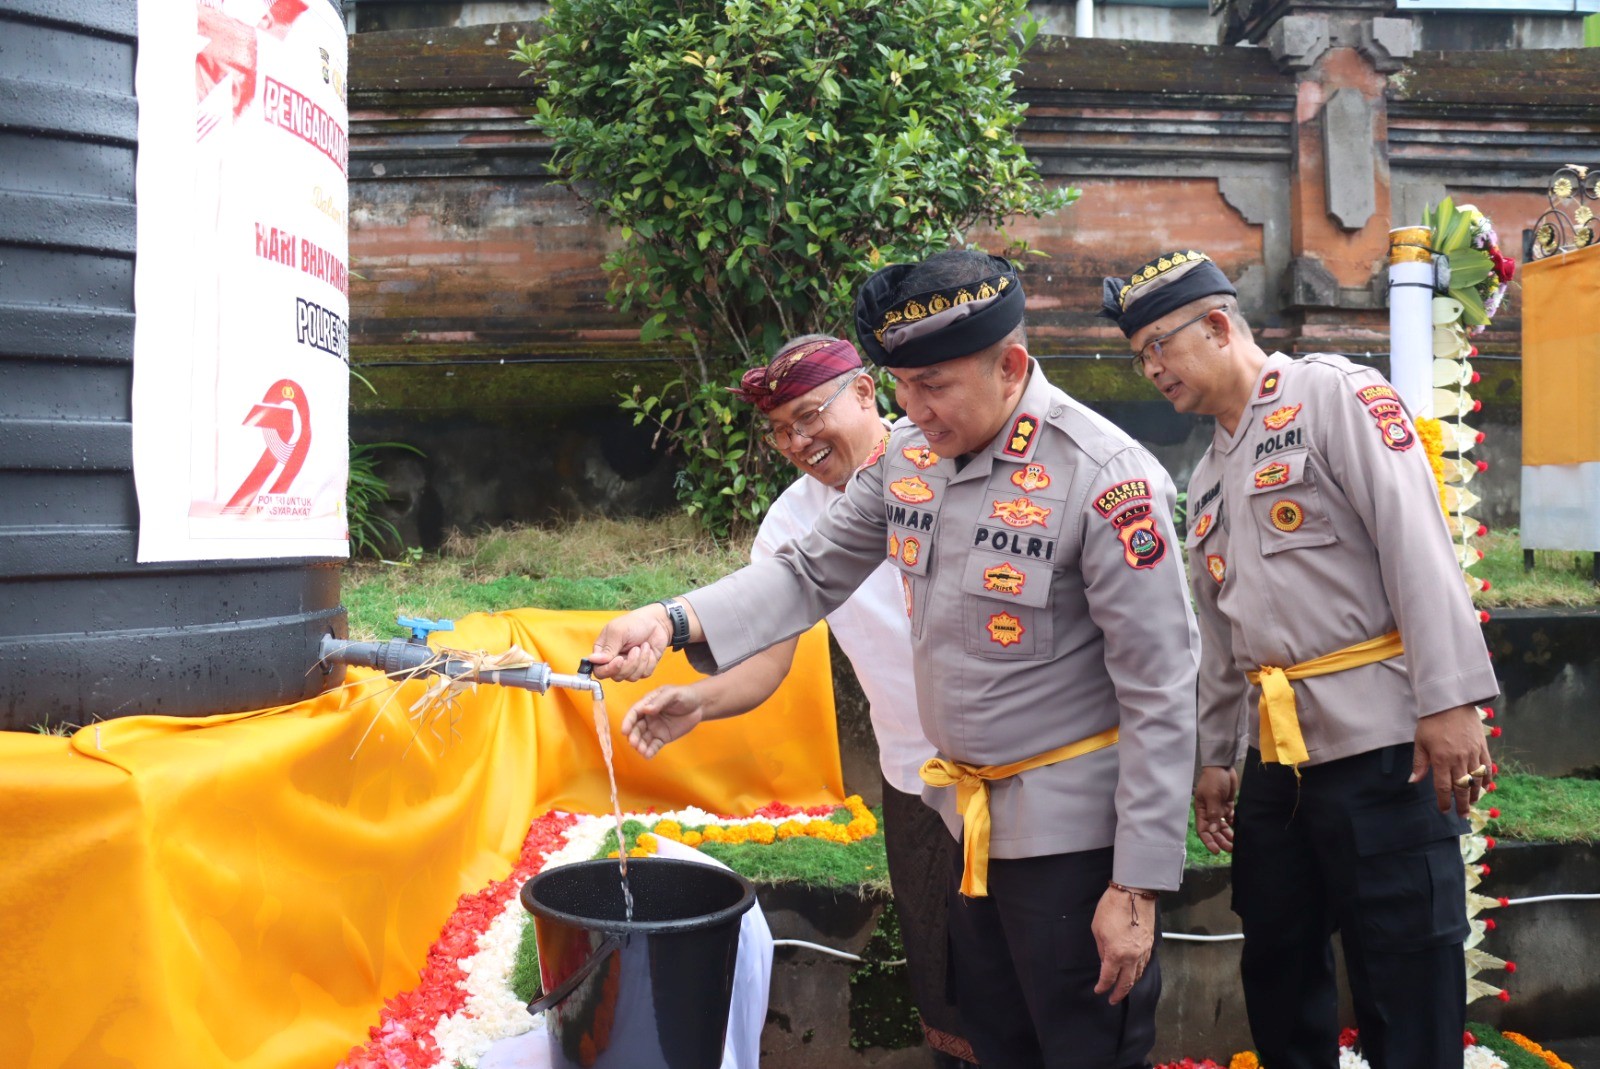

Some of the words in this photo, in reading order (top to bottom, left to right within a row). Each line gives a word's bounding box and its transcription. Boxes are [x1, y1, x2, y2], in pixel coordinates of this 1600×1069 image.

[264, 75, 344, 173] PENGADAAN
[255, 221, 296, 268] HARI
[296, 297, 342, 358] POLRES
[1256, 427, 1302, 459] POLRI
[287, 496, 312, 506] UNTUK
[1098, 481, 1145, 508] POLRES
[1105, 489, 1146, 511] GIANYAR
[886, 503, 933, 531] UMAR
[1117, 506, 1146, 523] BALI
[975, 527, 1054, 560] POLRI
